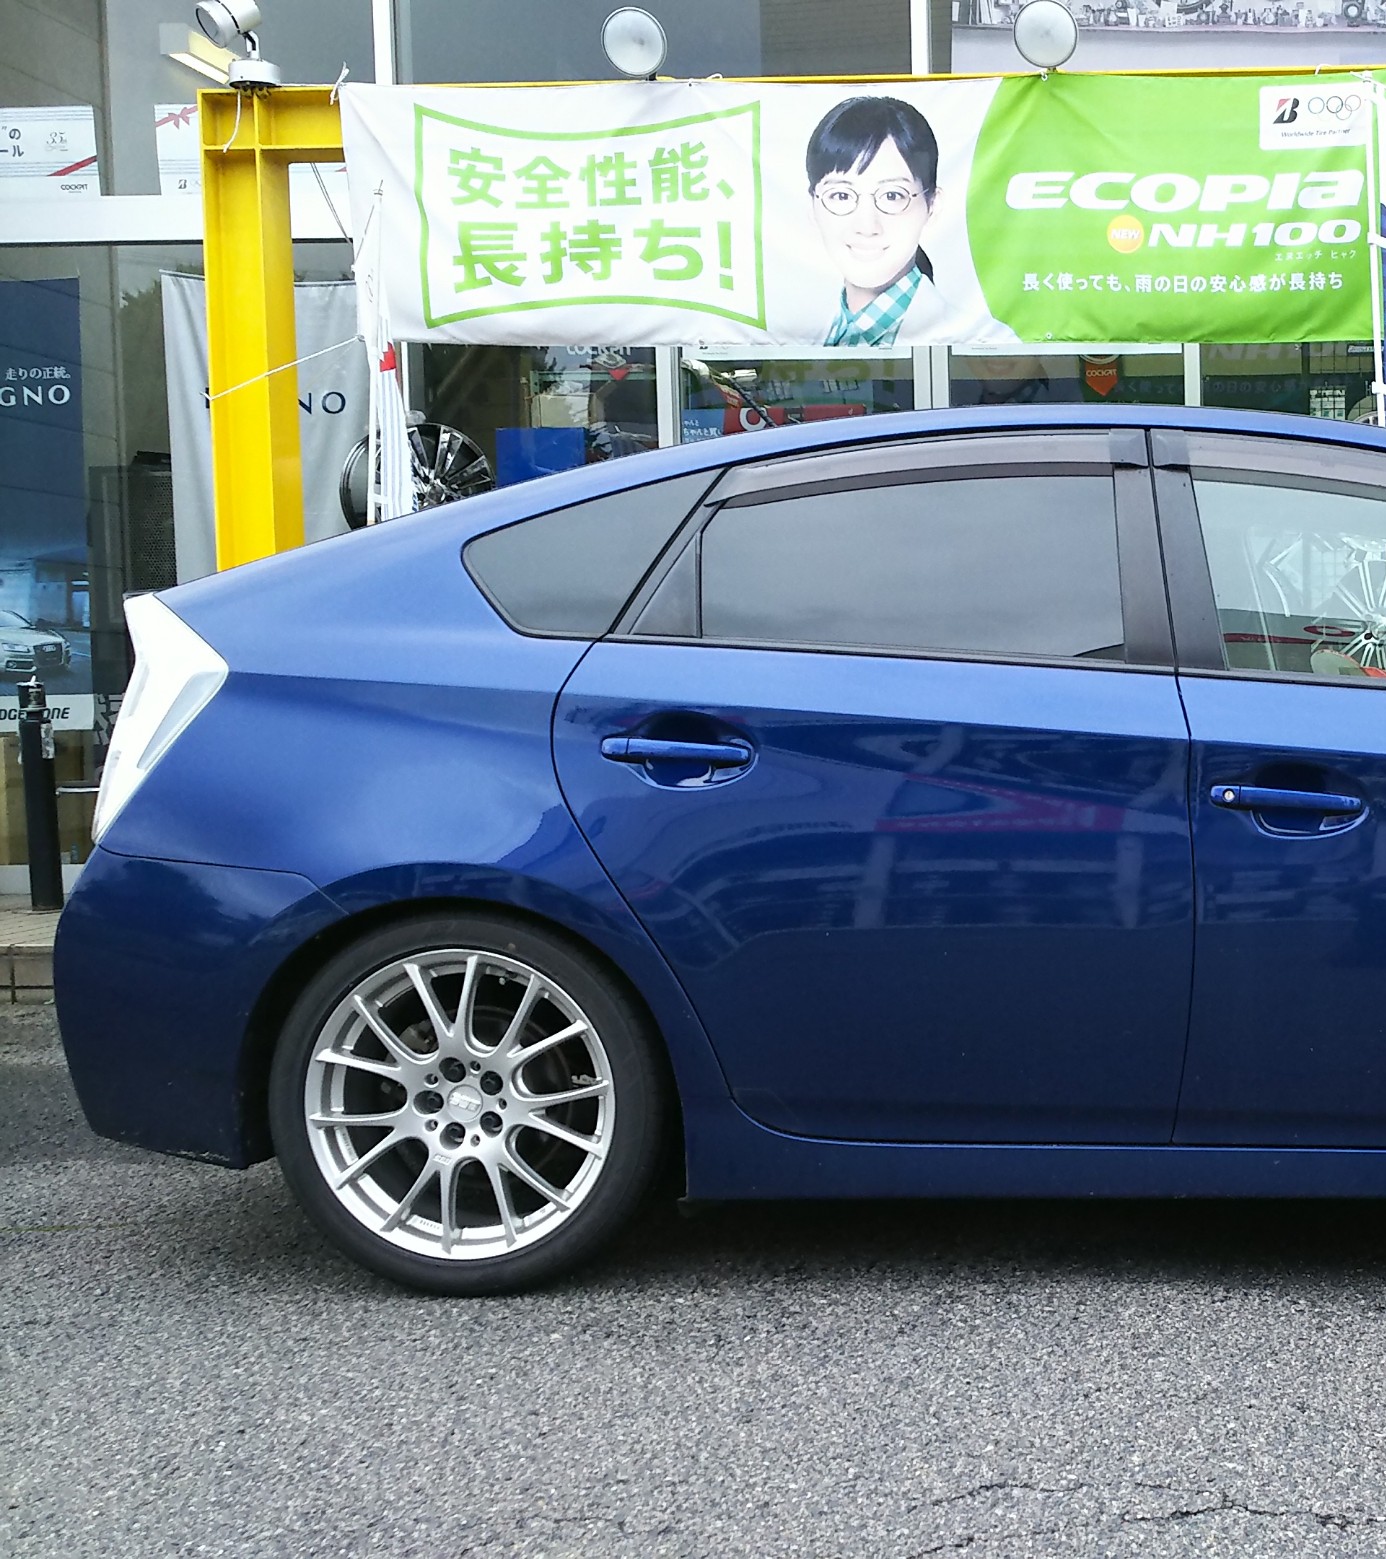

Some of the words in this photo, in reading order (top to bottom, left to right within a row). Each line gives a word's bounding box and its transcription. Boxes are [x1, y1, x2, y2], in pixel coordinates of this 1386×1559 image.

[447, 141, 735, 209] 安全性能、
[1111, 228, 1142, 240] NEW
[1148, 219, 1362, 249] NH100
